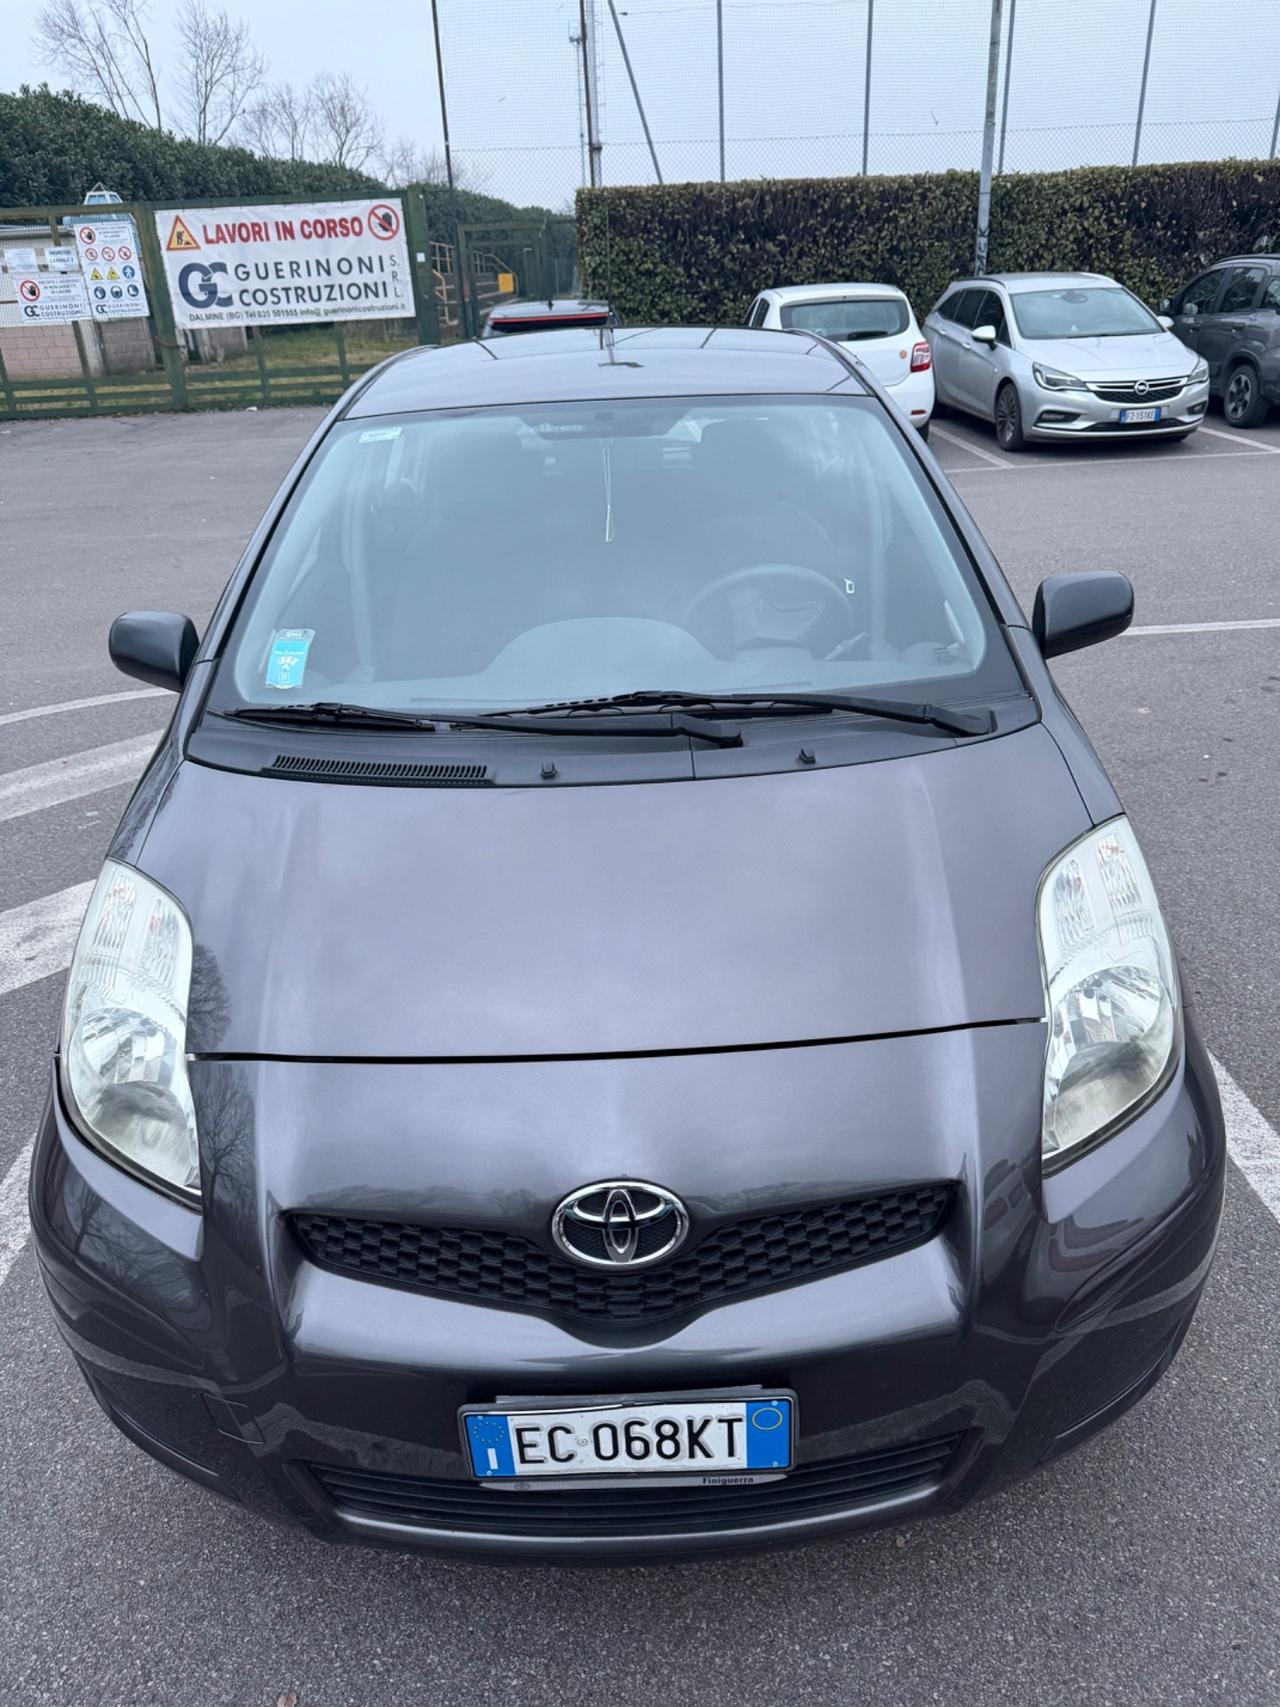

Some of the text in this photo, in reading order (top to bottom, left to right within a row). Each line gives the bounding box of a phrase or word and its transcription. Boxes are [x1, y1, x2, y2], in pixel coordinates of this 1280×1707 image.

[202, 216, 363, 245] LAVORI IN CORSO
[234, 255, 385, 282] GUERINONI
[239, 280, 389, 307] COSTRUZIONI
[189, 312, 225, 322] DALMINE
[515, 1426, 576, 1465] EC
[592, 1417, 744, 1462] 068KT
[702, 1476, 754, 1486] Finiguerra
